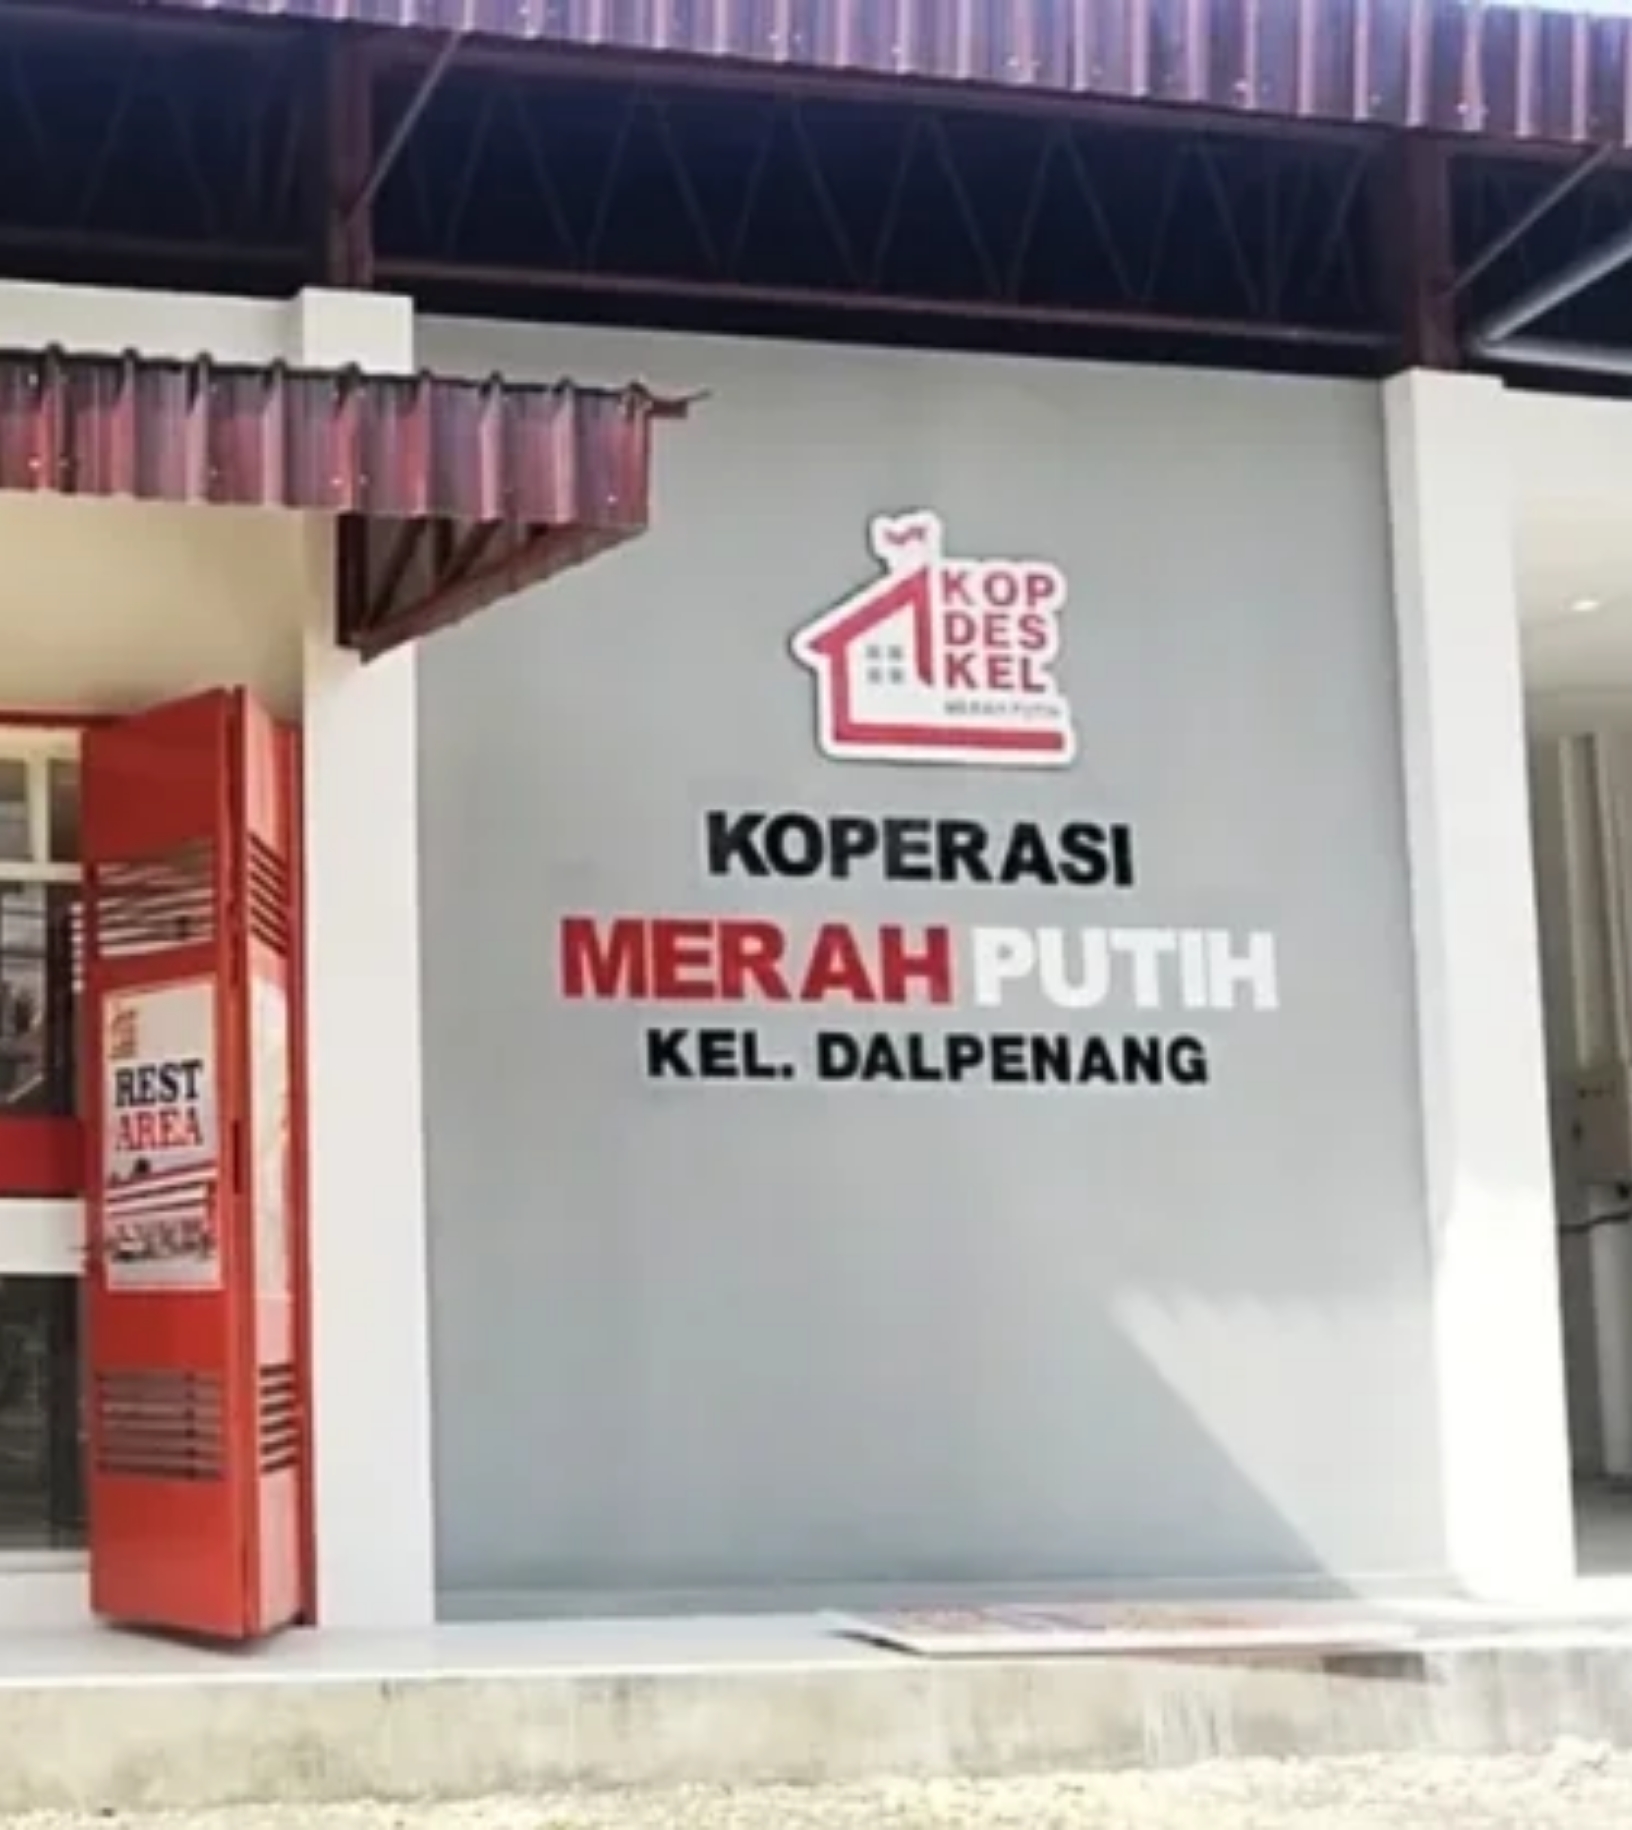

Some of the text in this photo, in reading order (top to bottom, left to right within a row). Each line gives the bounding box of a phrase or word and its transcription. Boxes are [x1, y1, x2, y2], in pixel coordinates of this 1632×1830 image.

[941, 569, 1056, 606] KOP
[944, 612, 1048, 649] DES
[945, 653, 1047, 692] KEL
[707, 811, 1134, 887] KOPERASI
[561, 918, 1277, 1007] MERAH PUTIH
[646, 1030, 1208, 1083] KEL. DALPENANG
[115, 1060, 202, 1107] REST
[117, 1107, 203, 1151] AREA
